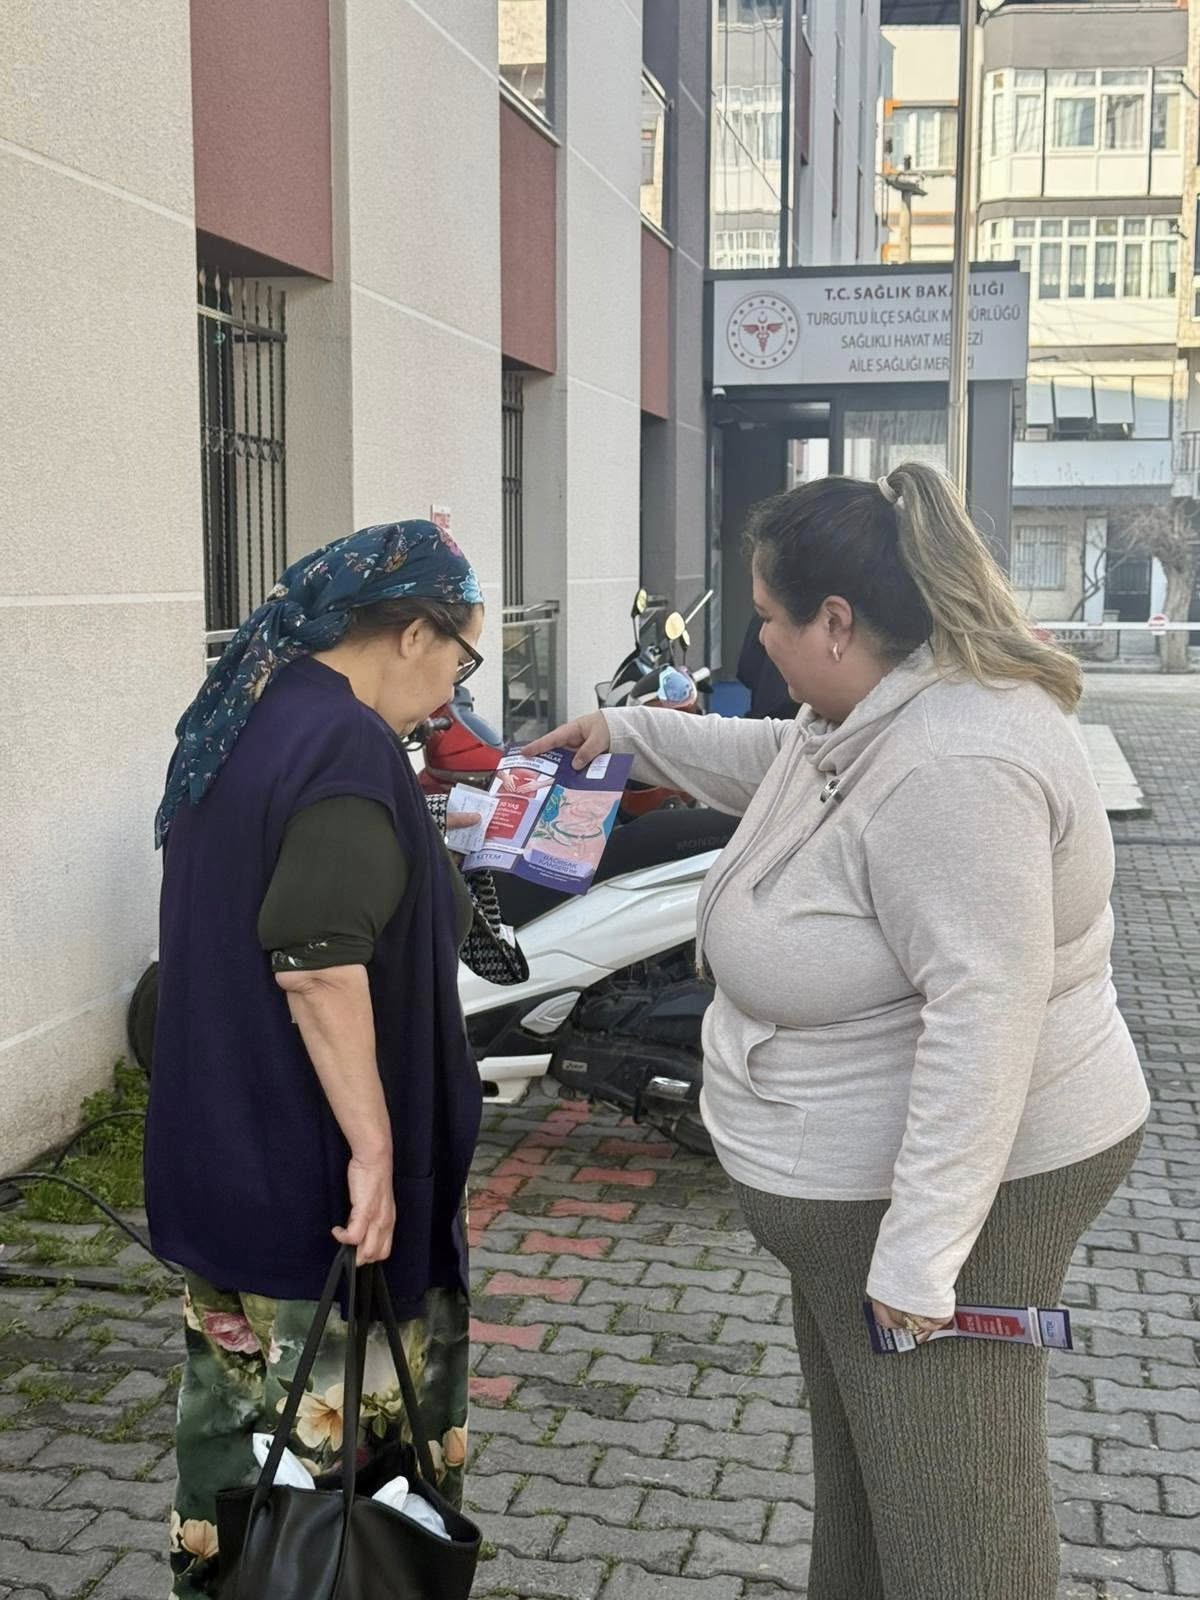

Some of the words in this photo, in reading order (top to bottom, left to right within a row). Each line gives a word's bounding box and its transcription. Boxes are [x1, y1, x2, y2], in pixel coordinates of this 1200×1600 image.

[824, 287, 851, 301] T.C.
[853, 283, 912, 300] SAĞLIK
[916, 280, 1005, 298] BAKLIĞI
[806, 310, 869, 327] TURGUTLU
[870, 307, 896, 328] İLÇE
[898, 307, 939, 325] SAĞLIK
[941, 304, 1021, 323] MÜRLÜĞÜ
[841, 332, 892, 350] SAĞLIKLI
[893, 332, 931, 348] HAYAT
[932, 329, 984, 348] MEEZİ
[849, 357, 874, 374] AİLE
[876, 355, 922, 373] SAĞLIĞI
